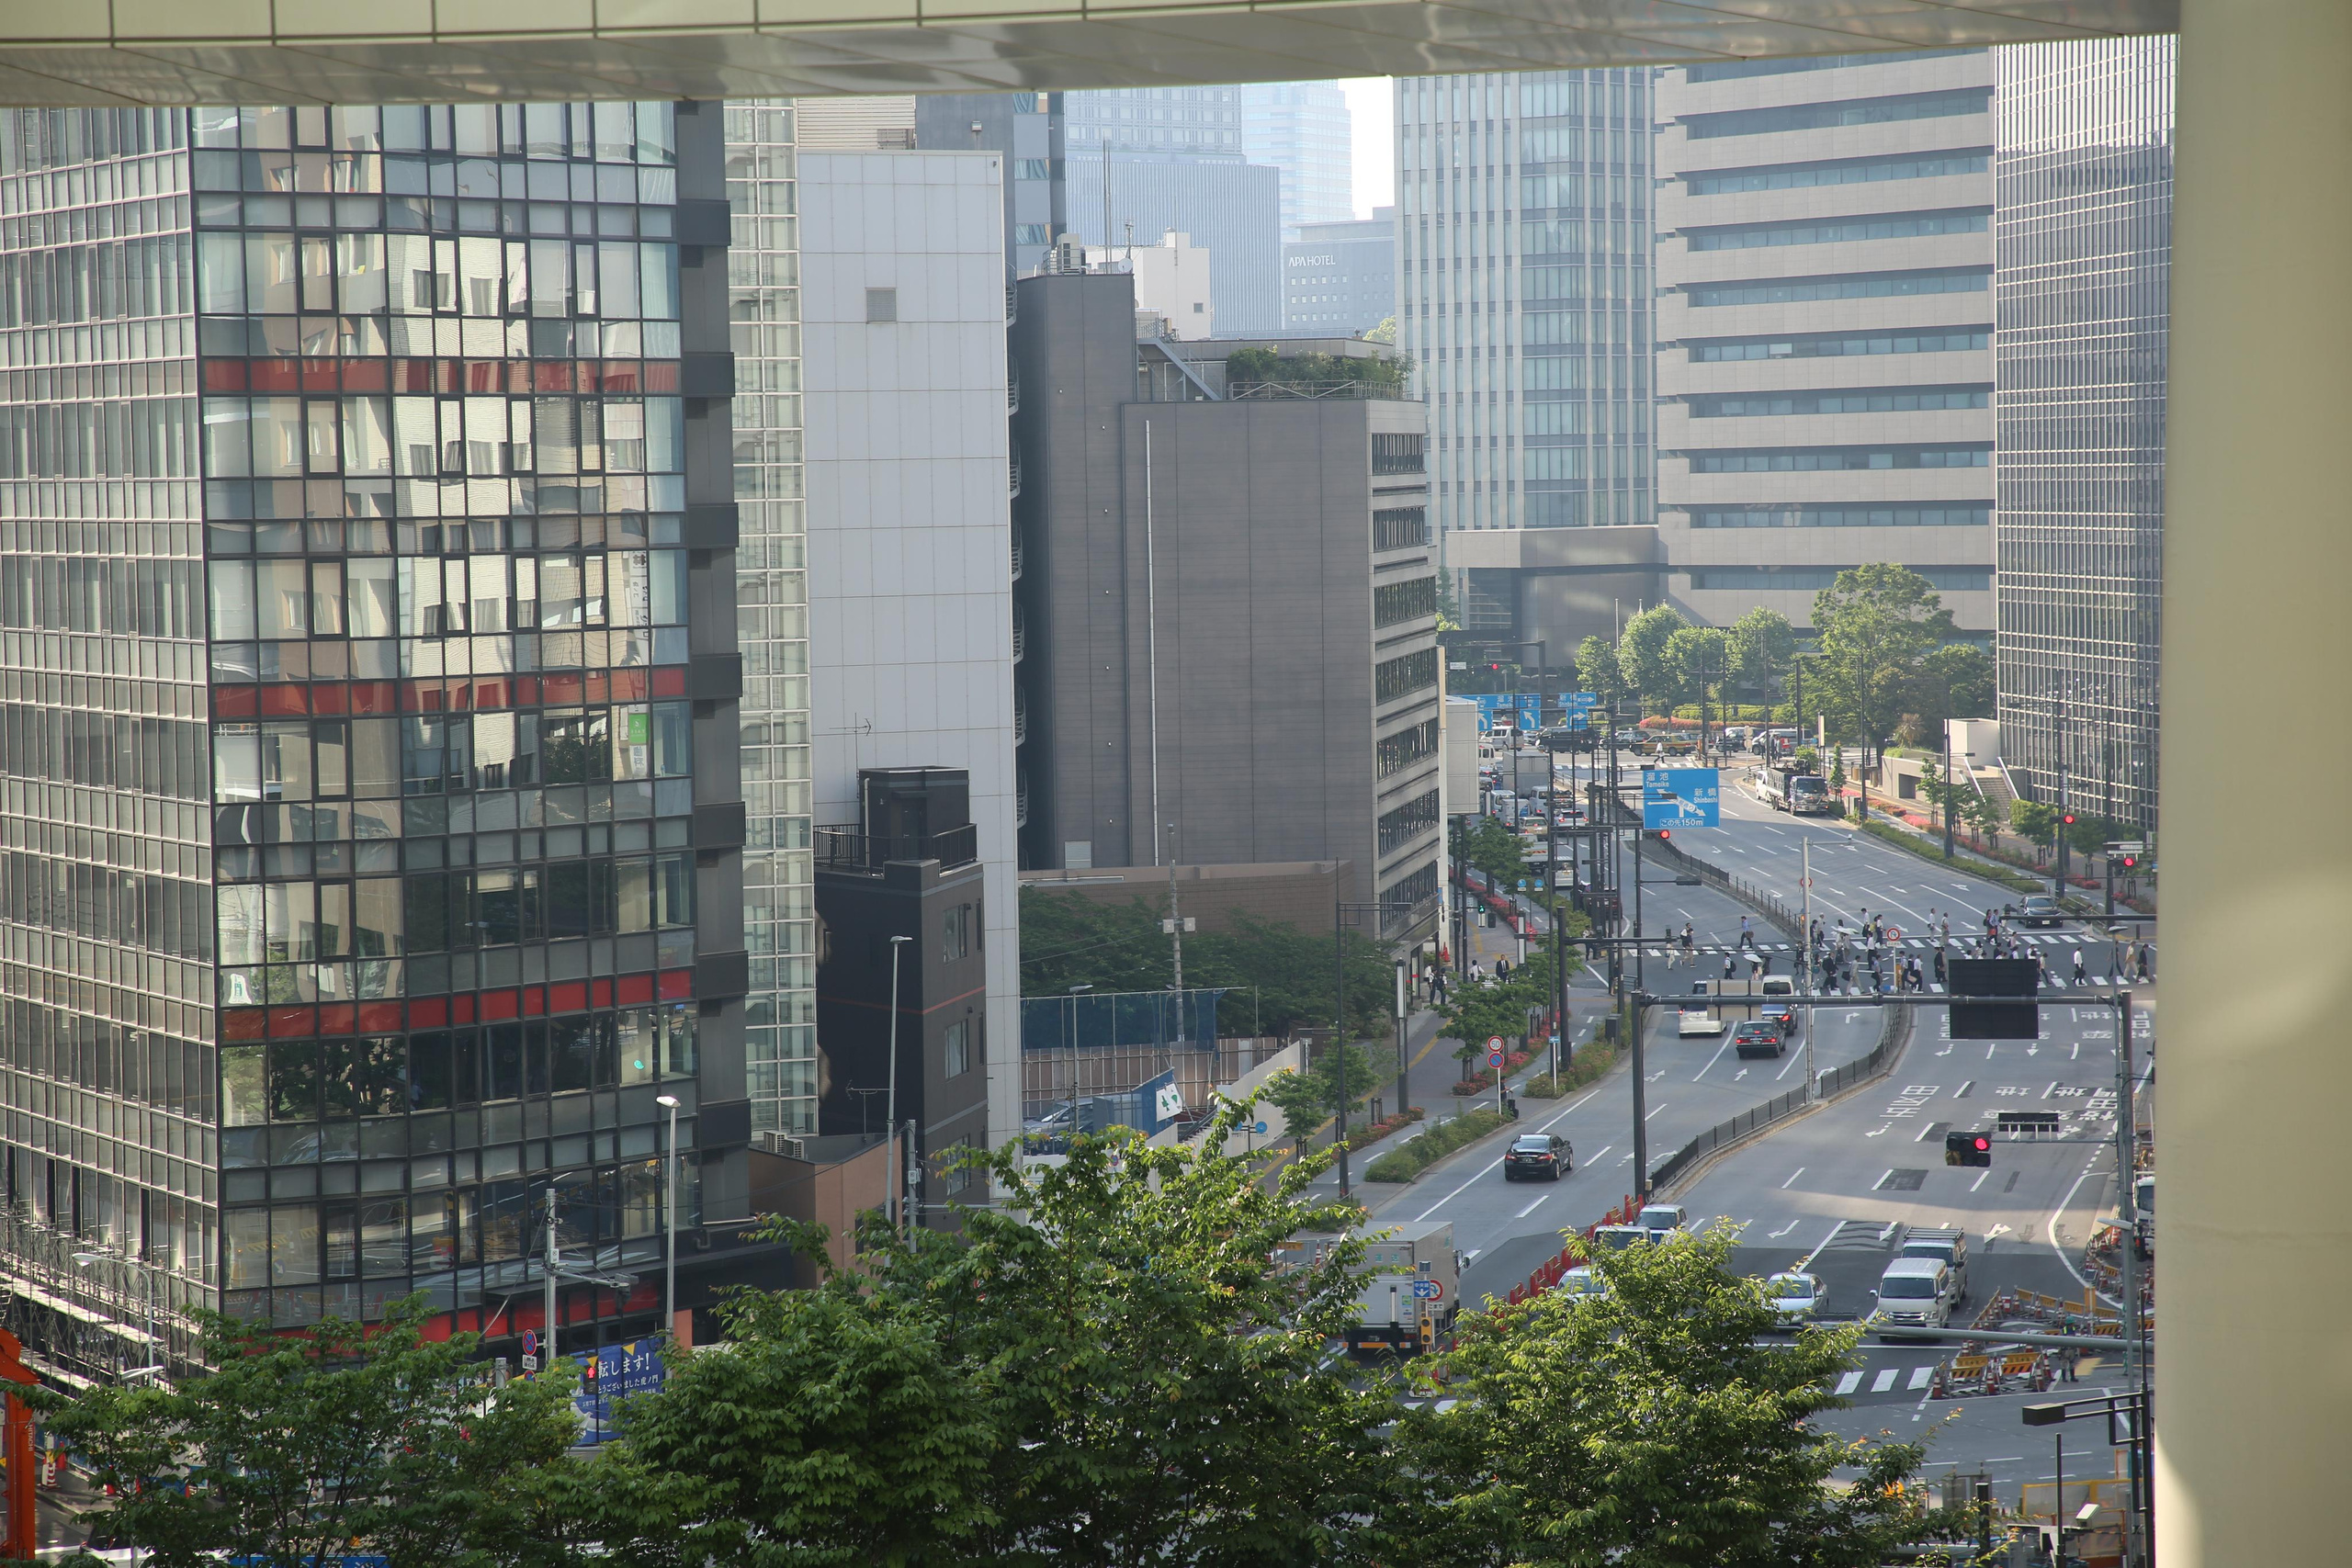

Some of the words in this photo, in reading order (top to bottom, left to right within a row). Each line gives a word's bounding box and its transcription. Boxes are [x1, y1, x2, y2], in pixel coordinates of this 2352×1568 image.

[1288, 256, 1306, 267] APA
[1307, 254, 1336, 266] HOTEL
[1693, 787, 1717, 797] 新橋
[1660, 818, 1703, 827] この先150m
